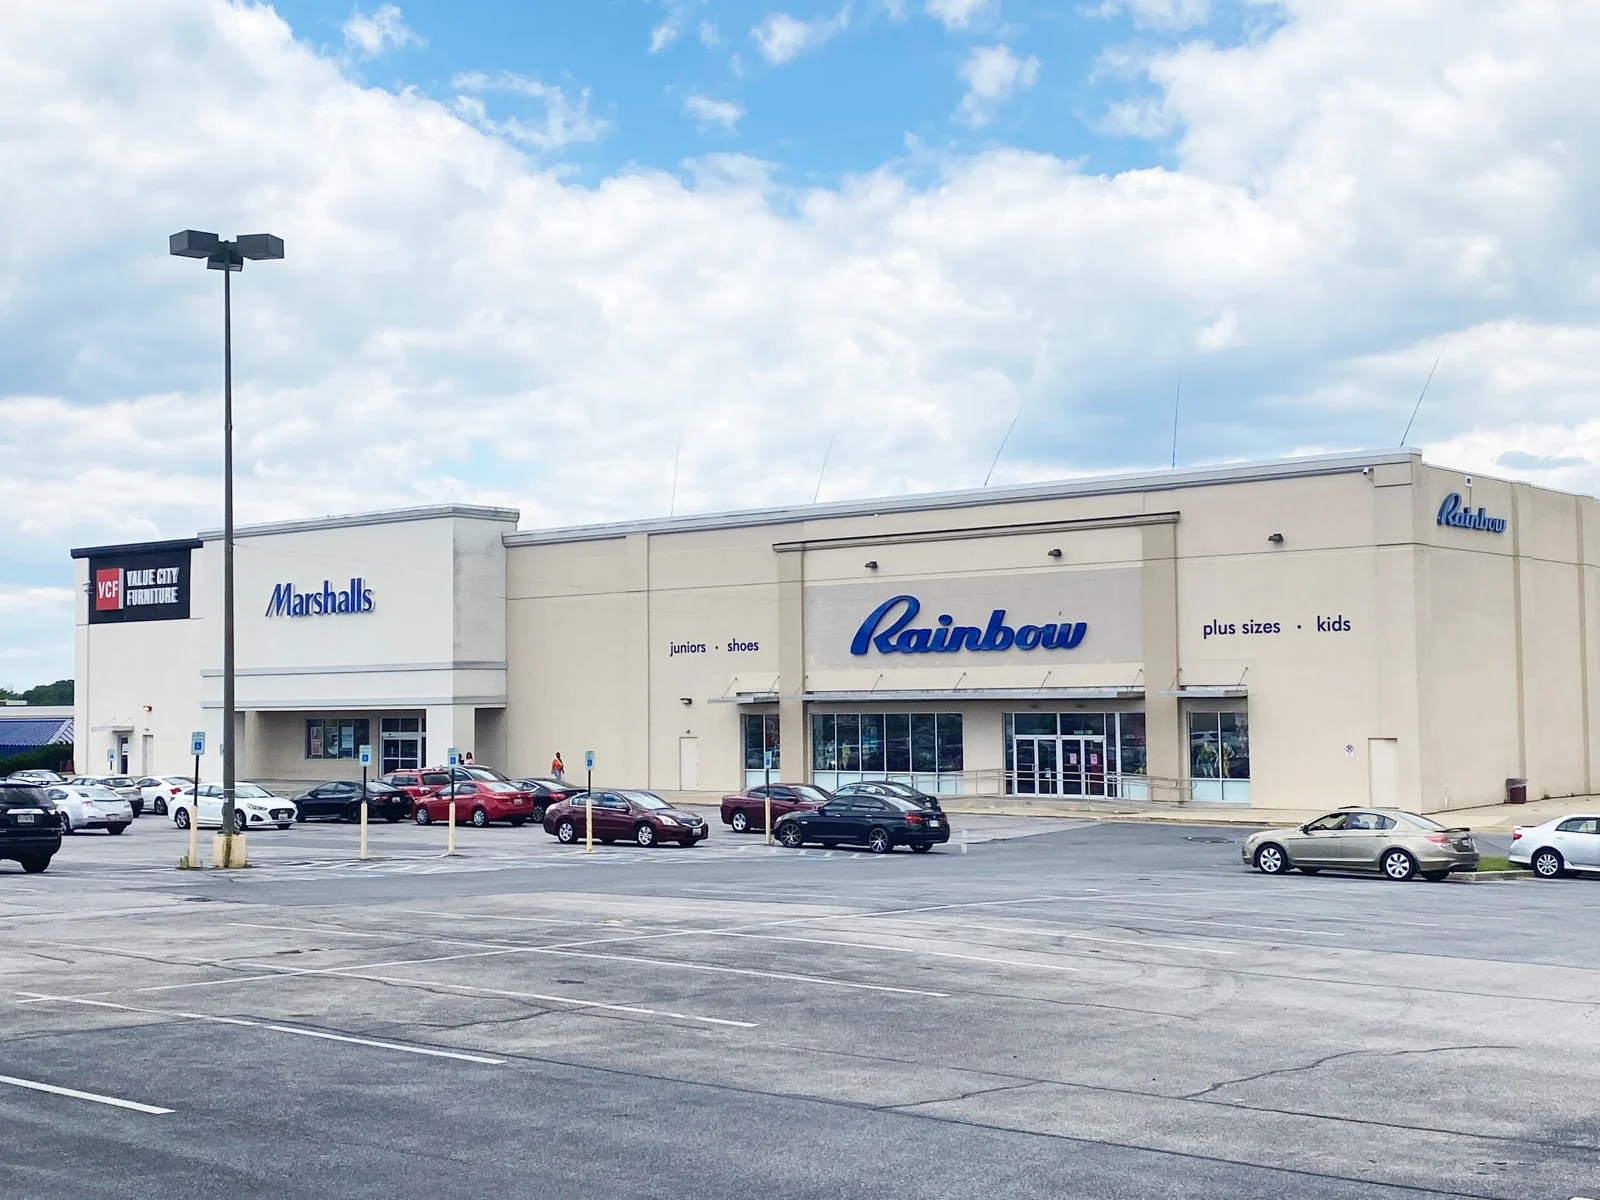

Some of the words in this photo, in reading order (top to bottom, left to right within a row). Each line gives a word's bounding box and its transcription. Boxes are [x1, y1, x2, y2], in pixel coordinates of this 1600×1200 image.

[1437, 492, 1507, 533] Rainbow
[126, 569, 156, 587] VALUE
[157, 567, 180, 585] CITY
[98, 580, 119, 599] VCF
[126, 586, 179, 606] FURNITURE
[265, 577, 374, 618] Marshalls
[850, 594, 1087, 656] Rainbow
[1203, 619, 1236, 640] plus
[1241, 619, 1281, 635] sizes
[1316, 614, 1351, 632] kids
[669, 641, 706, 657] juniors
[727, 637, 759, 652] shoes
